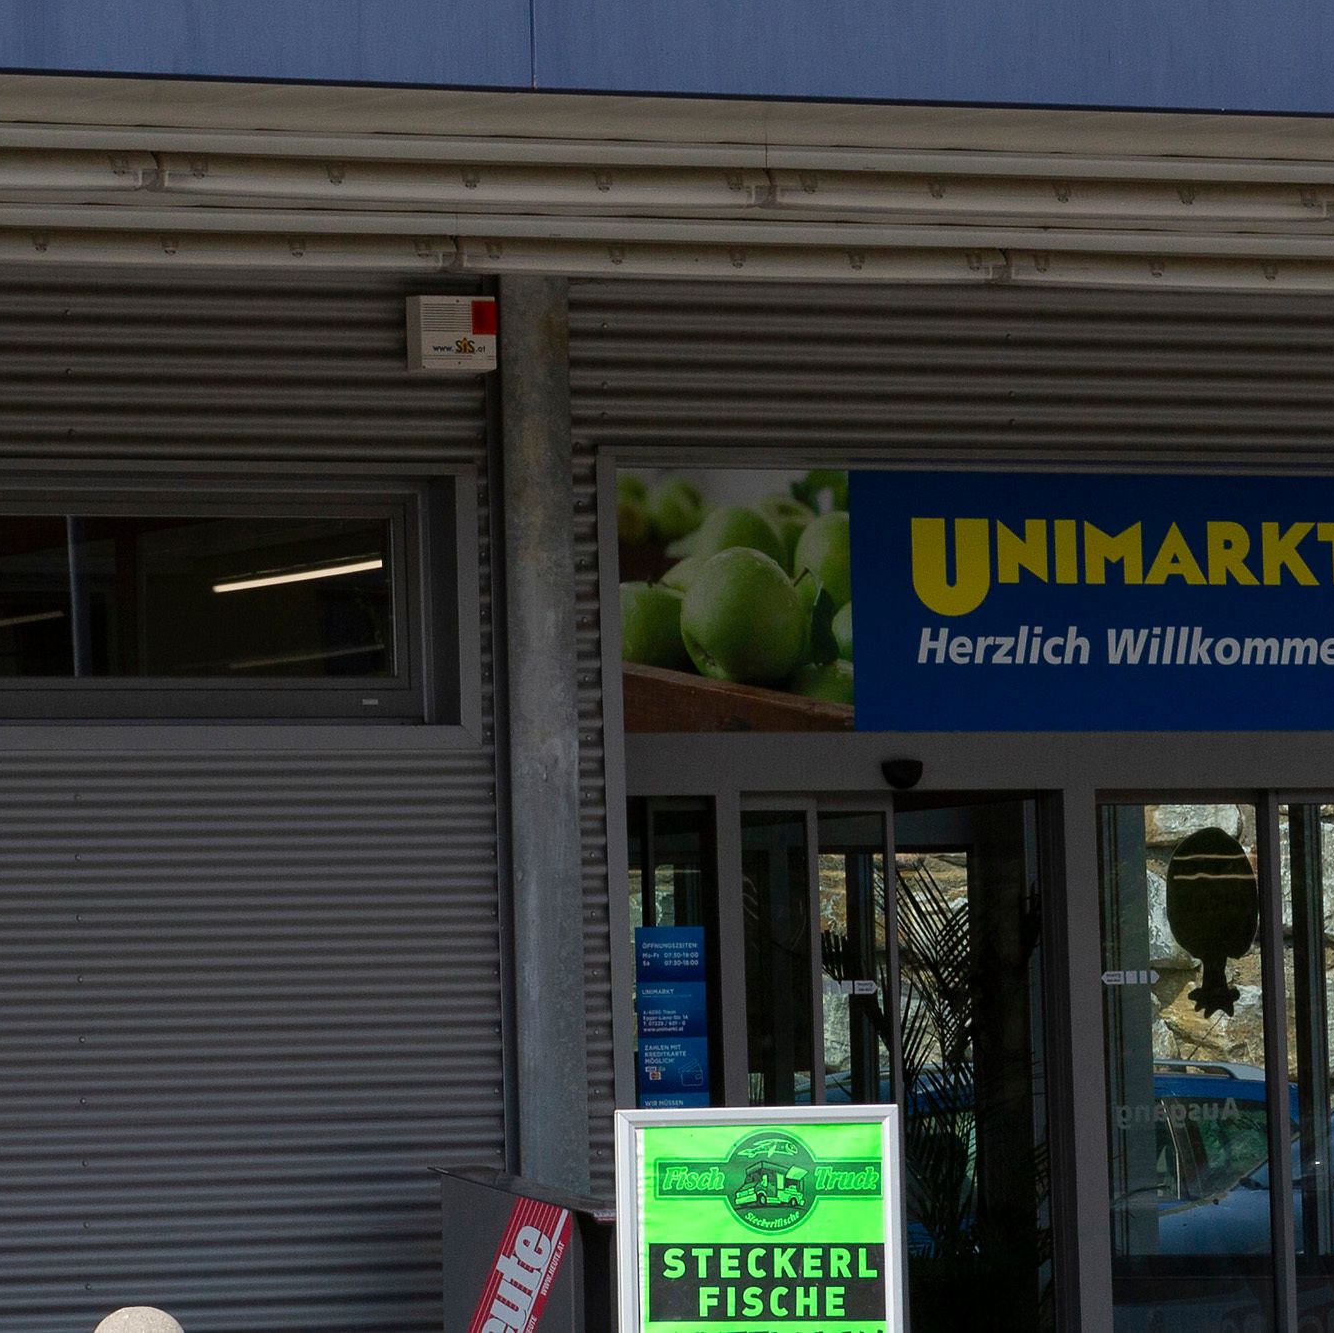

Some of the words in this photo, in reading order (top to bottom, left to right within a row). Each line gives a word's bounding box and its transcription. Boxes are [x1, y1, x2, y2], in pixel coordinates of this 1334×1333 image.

[917, 625, 1091, 666] Herzlich
[662, 1166, 725, 1191] Fisch
[814, 1165, 879, 1191] Truck
[662, 1246, 879, 1279] STECKERL
[698, 1286, 847, 1317] FISCHE
